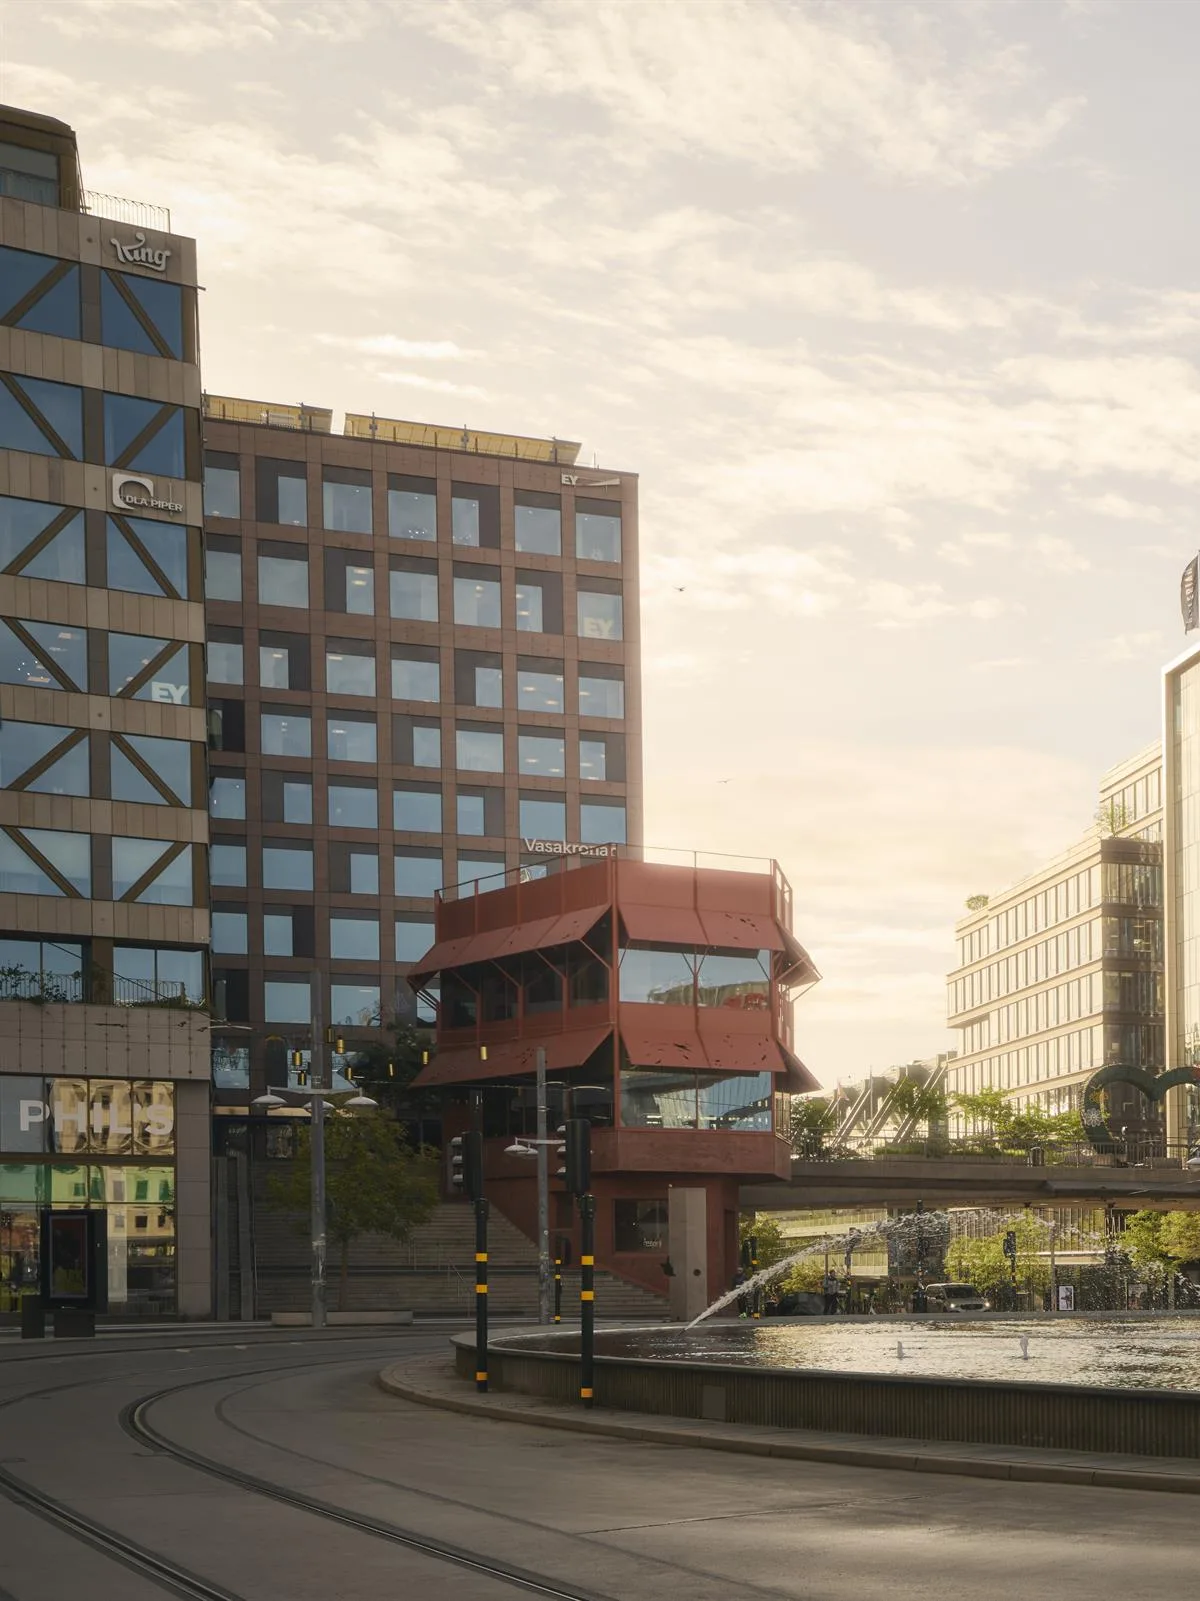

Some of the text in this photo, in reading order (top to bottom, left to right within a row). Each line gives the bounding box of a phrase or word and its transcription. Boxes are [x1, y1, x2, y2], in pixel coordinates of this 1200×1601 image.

[110, 232, 171, 272] King
[561, 473, 578, 486] EY
[125, 495, 184, 512] DLA PIPER
[583, 617, 614, 638] EY
[151, 681, 189, 705] EY
[19, 1099, 175, 1136] PHIL'S
